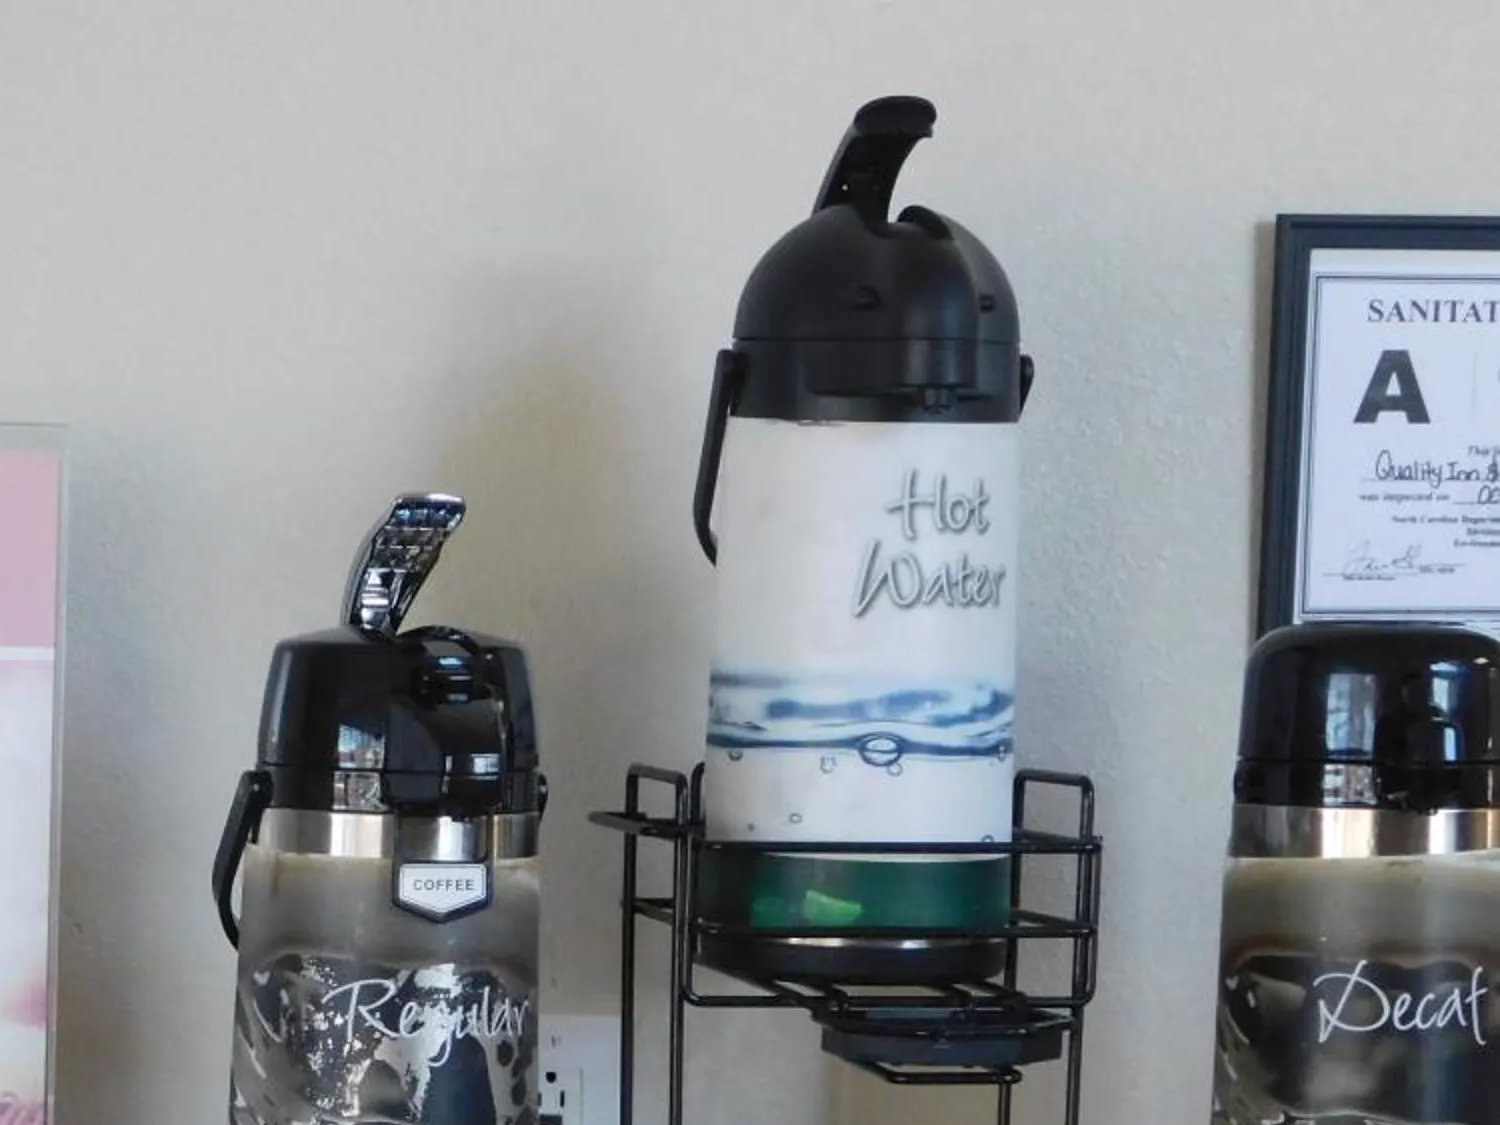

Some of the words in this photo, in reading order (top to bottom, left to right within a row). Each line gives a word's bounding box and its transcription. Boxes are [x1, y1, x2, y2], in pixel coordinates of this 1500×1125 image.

[1352, 349, 1431, 424] A
[885, 469, 990, 541] Hot
[1375, 449, 1442, 489] Quality
[1443, 461, 1480, 481] Inn
[853, 538, 1006, 618] Water
[413, 879, 475, 891] COFFEE
[321, 978, 528, 1067] Regular
[1312, 959, 1488, 1045] Decaf
